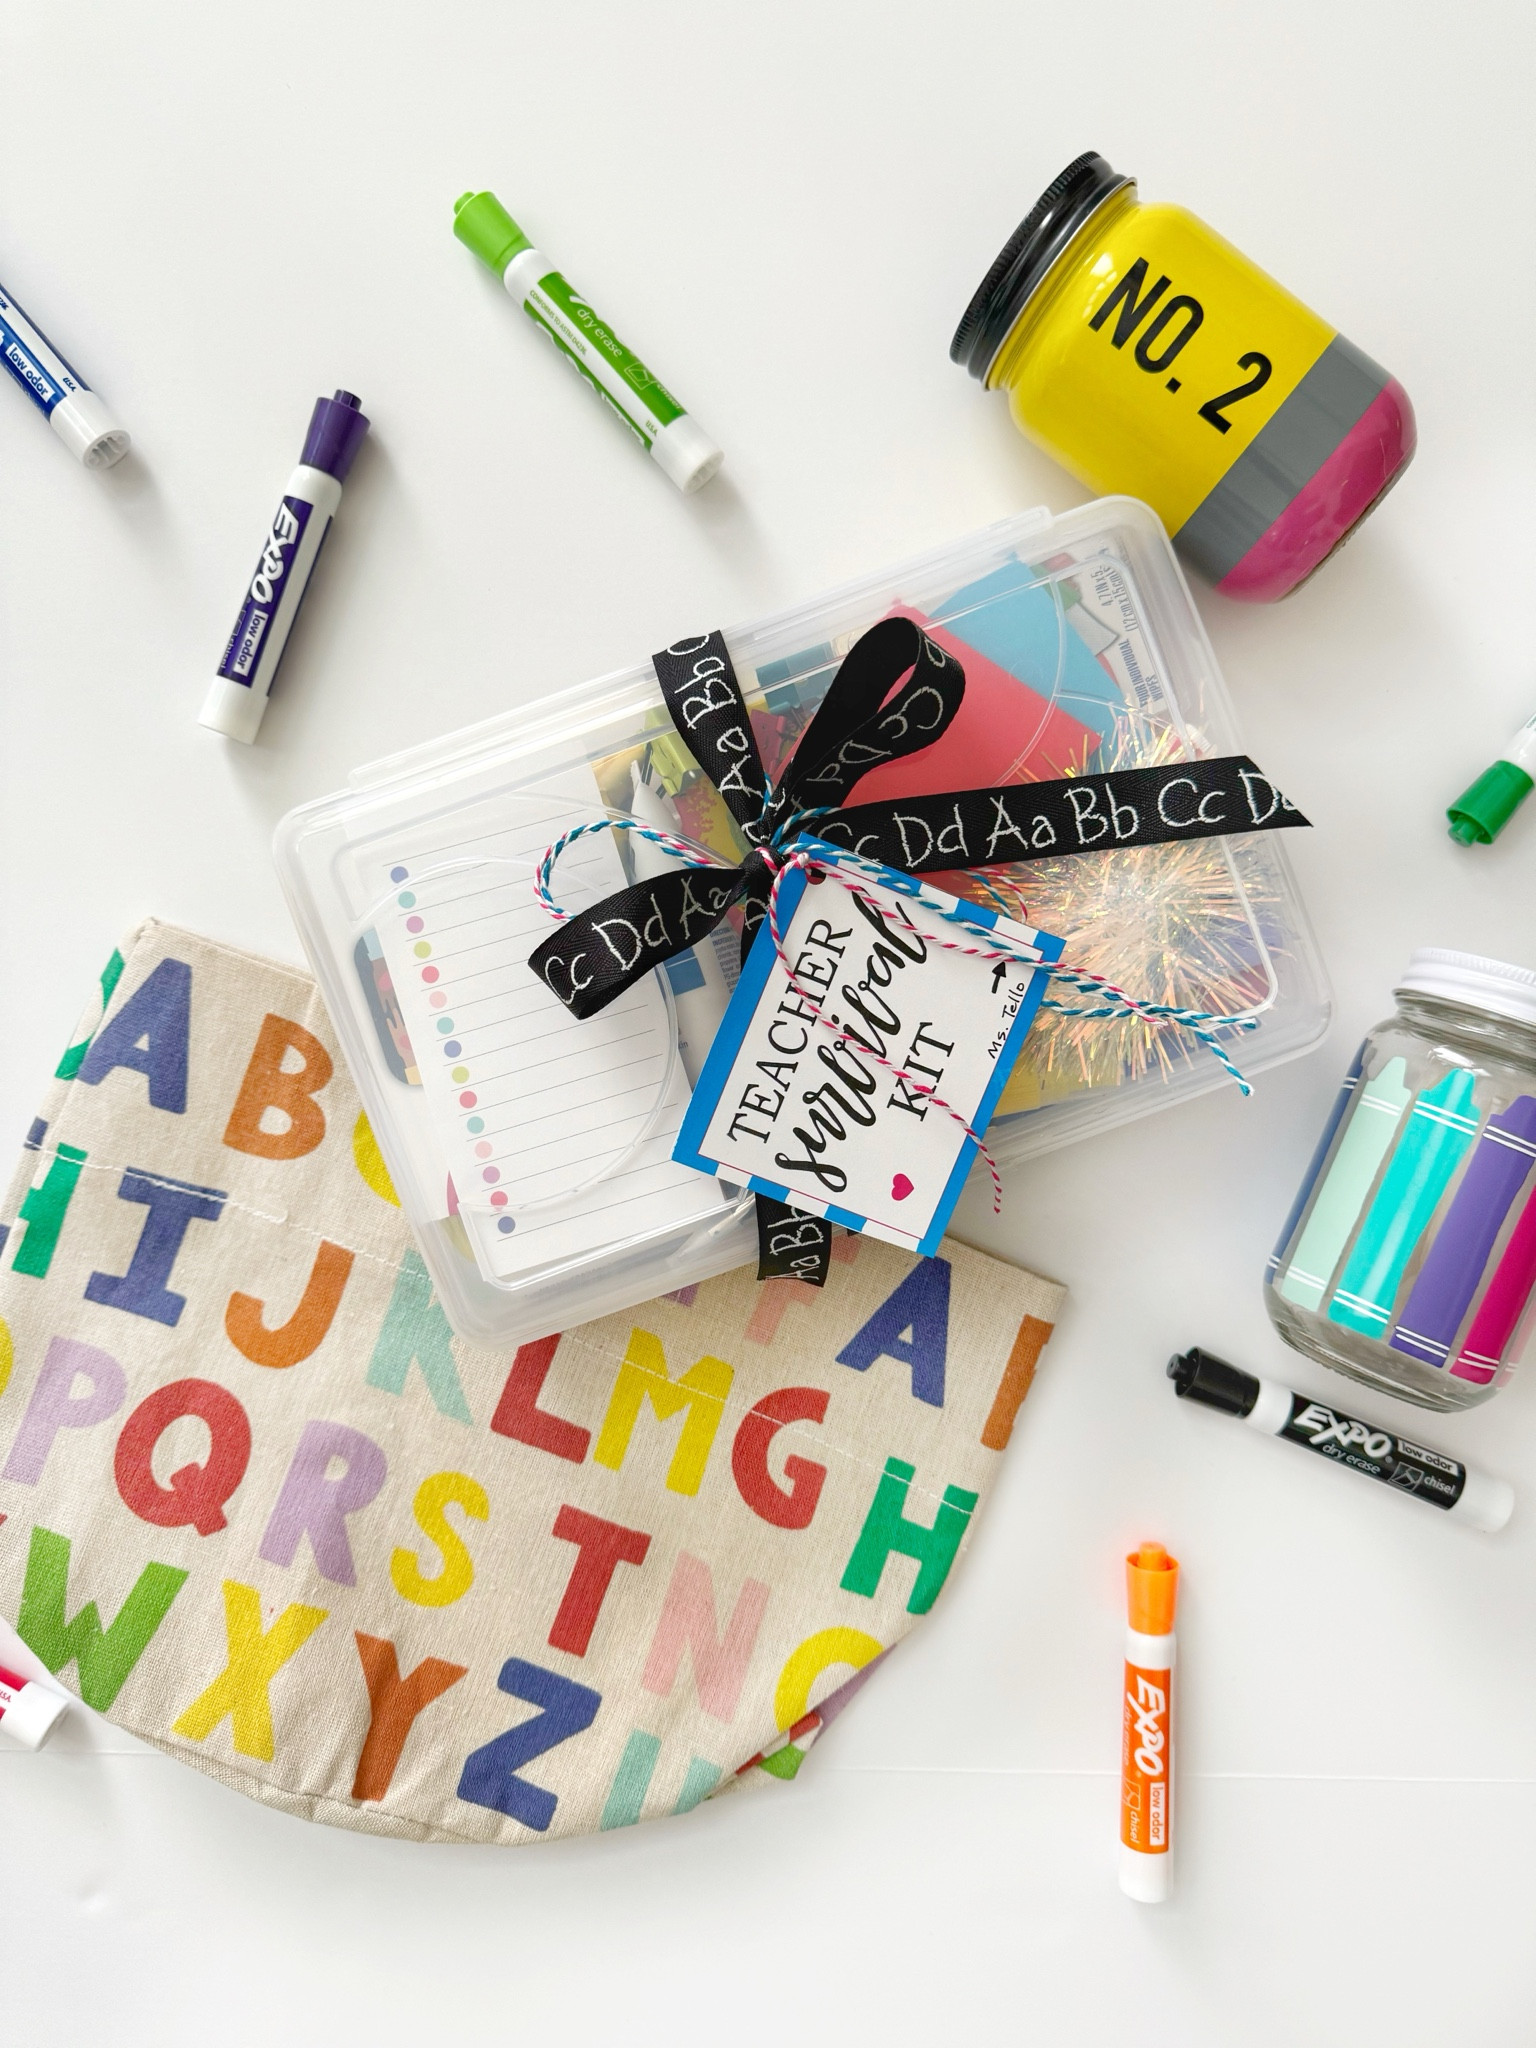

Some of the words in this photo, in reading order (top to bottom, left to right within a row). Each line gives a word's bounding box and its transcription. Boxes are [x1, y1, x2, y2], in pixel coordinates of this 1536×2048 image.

[9, 347, 28, 371] low
[26, 370, 49, 396] odor
[577, 308, 597, 328] dry
[595, 328, 623, 358] erase
[1088, 256, 1204, 394] NO.
[1197, 351, 1272, 435] 2
[251, 502, 299, 604] EXPO
[236, 637, 254, 671] odor
[248, 613, 266, 639] low
[1118, 639, 1145, 686] INDIVIDUAL
[893, 803, 969, 868] Dd
[986, 795, 1056, 859] Aa
[1064, 783, 1140, 845] Bb
[1157, 778, 1226, 827] Cc
[544, 953, 594, 1004] Cc
[591, 893, 673, 971] Dd
[680, 875, 732, 940] Aa
[76, 957, 192, 1114] A
[222, 1012, 334, 1160] B
[726, 918, 853, 1144] TEACHER
[774, 886, 927, 1193] survival
[987, 1027, 1009, 1059] Ms.
[1001, 982, 1025, 1018] Tello
[887, 1021, 956, 1122] KIT
[835, 1256, 952, 1408] A
[83, 1166, 229, 1328] I
[224, 1239, 355, 1369] J
[490, 1332, 592, 1464] L
[593, 1326, 734, 1497] M
[731, 1386, 831, 1530] G
[839, 1456, 979, 1616] H
[1293, 1403, 1393, 1459] EXPO
[1323, 1442, 1345, 1460] dry
[1345, 1453, 1381, 1475] erase
[1401, 1443, 1424, 1461] low
[1424, 1452, 1454, 1472] odor
[1423, 1473, 1456, 1495] chisel
[4, 1335, 127, 1486] P
[114, 1377, 252, 1538] Q
[259, 1420, 388, 1587] R
[390, 1471, 490, 1608] S
[547, 1503, 652, 1658] T
[641, 1551, 771, 1723] N
[17, 1525, 190, 1713] W
[171, 1579, 329, 1763] X
[351, 1630, 469, 1802] Y
[456, 1656, 603, 1832] Z
[1127, 1674, 1166, 1777] EXPO
[1130, 1810, 1142, 1844] chisel
[1152, 1786, 1164, 1810] low
[1152, 1811, 1165, 1841] odor
